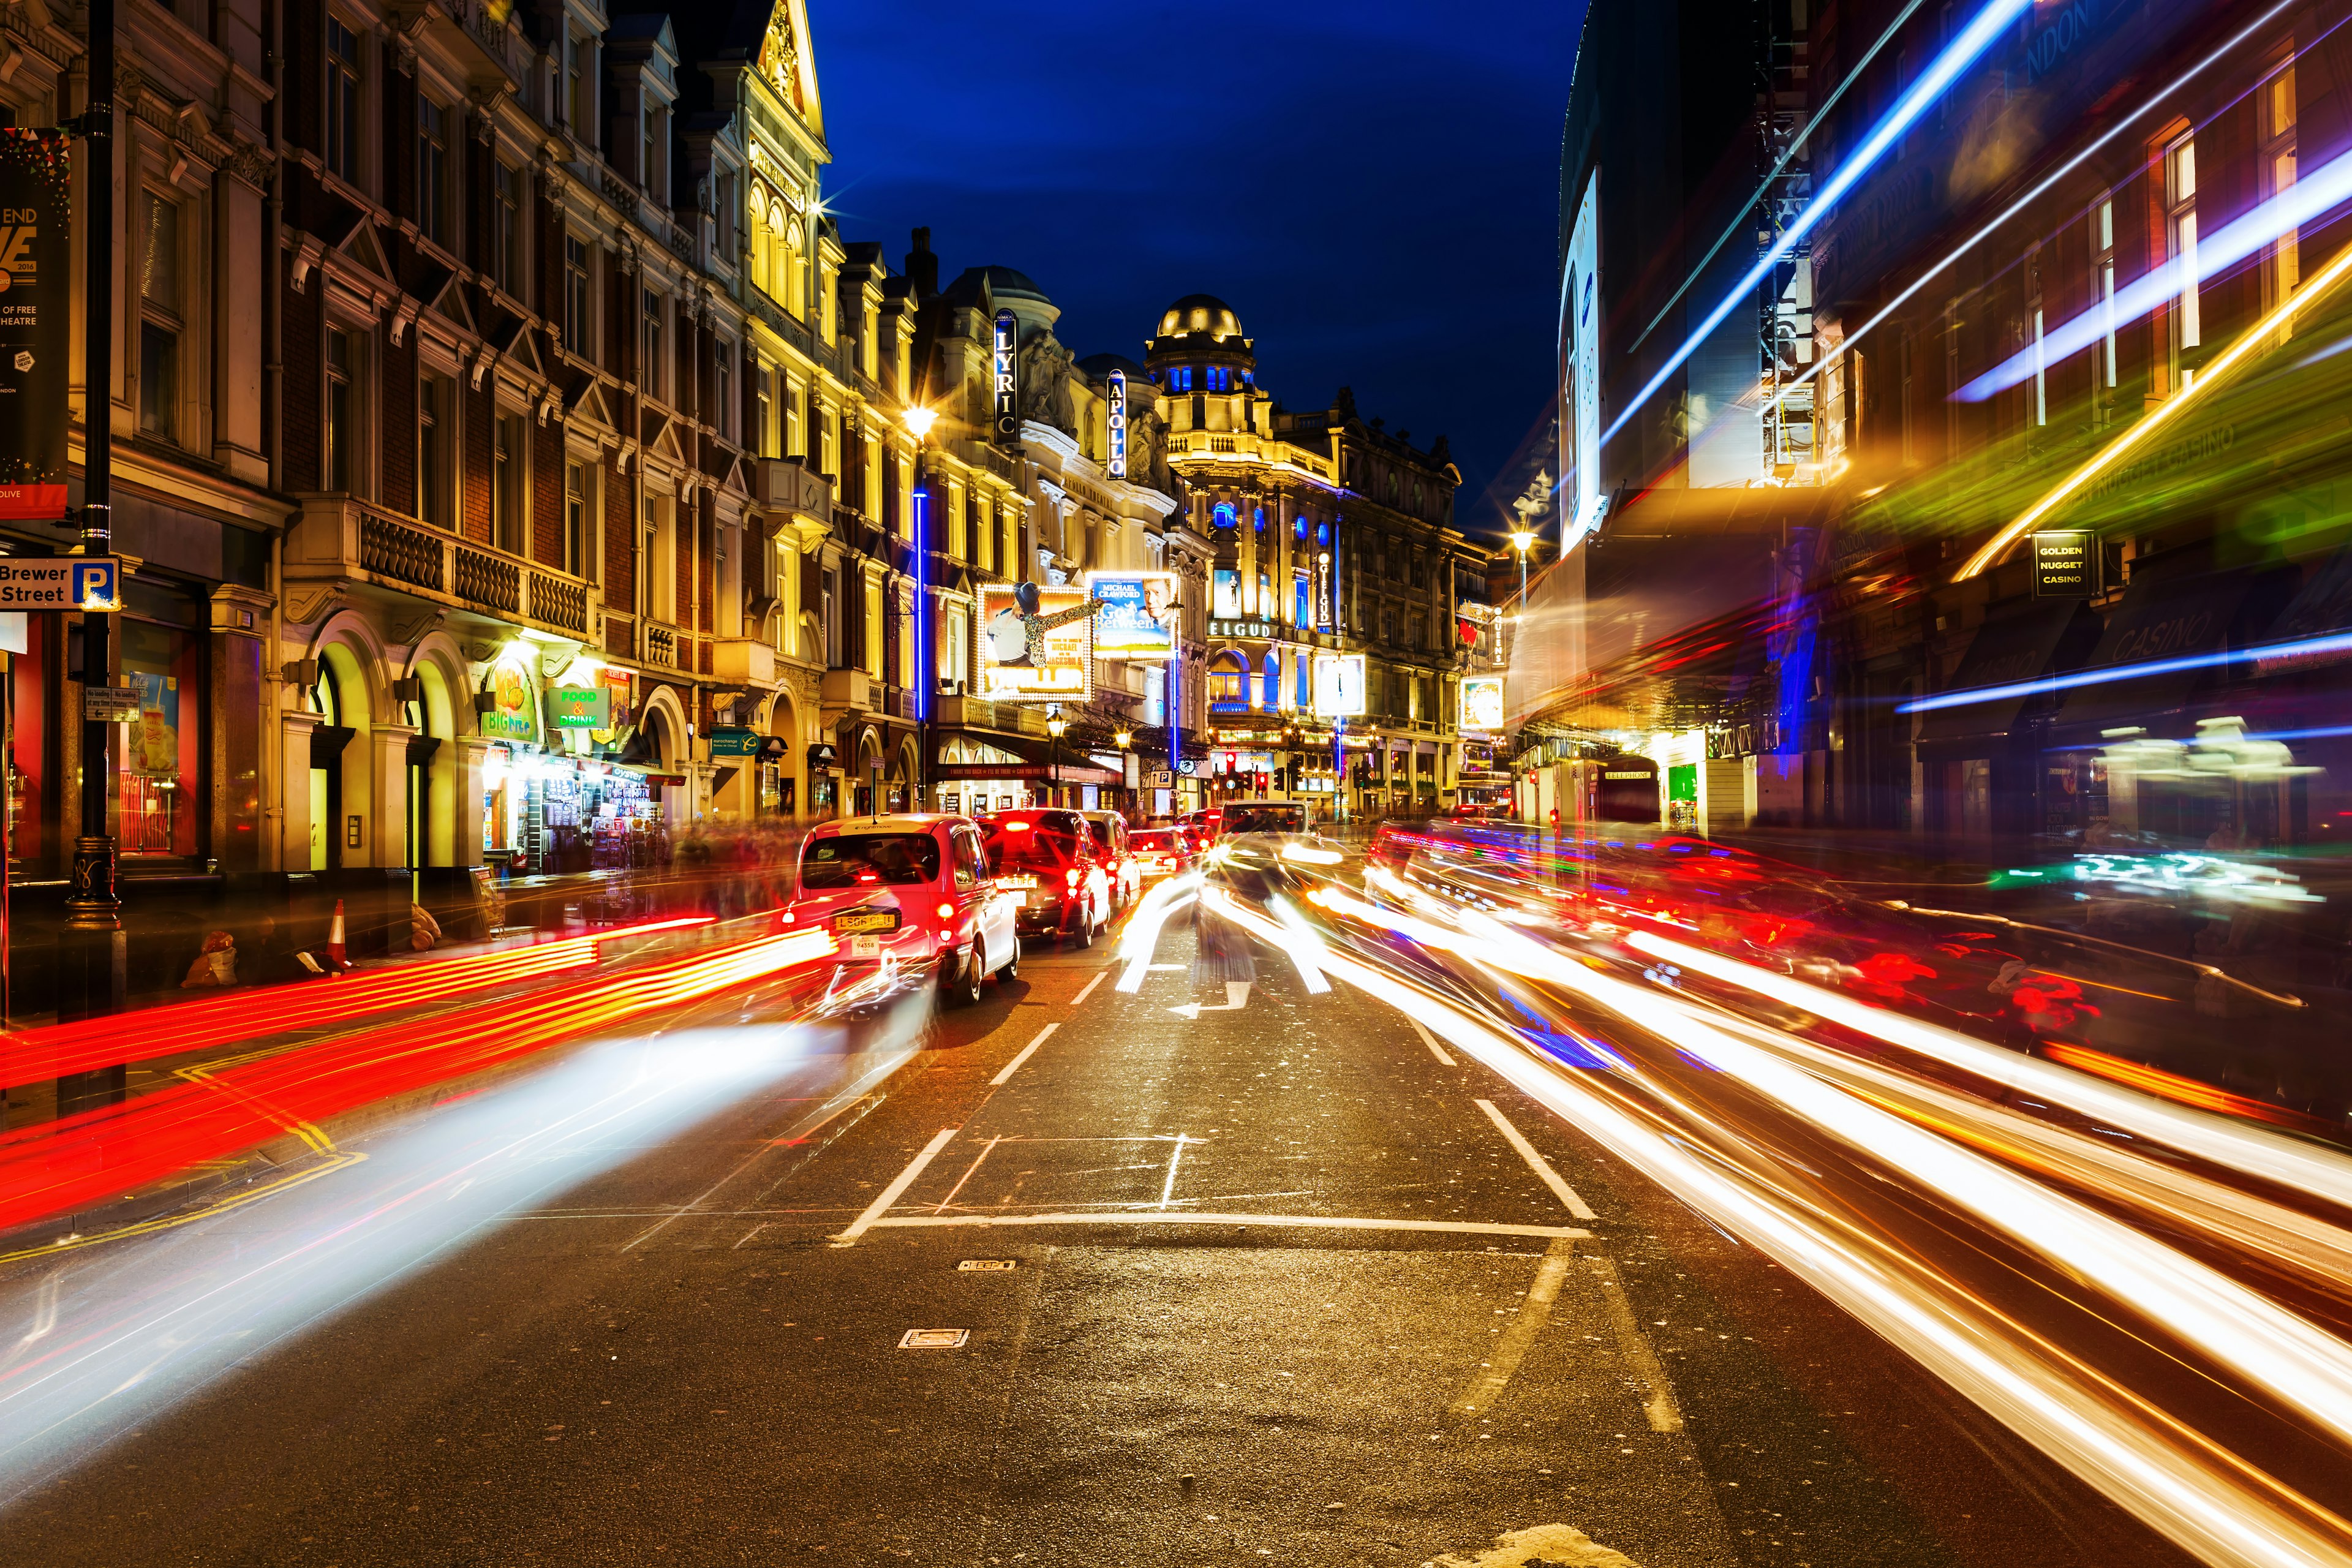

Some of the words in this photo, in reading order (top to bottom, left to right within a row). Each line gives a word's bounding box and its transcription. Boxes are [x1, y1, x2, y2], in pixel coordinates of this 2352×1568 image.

[3, 208, 37, 224] END
[997, 333, 1015, 434] LYRIC
[1109, 385, 1124, 474] APOLLO
[1065, 476, 1086, 496] APOLLO
[2040, 547, 2082, 556] GOLDEN
[0, 565, 67, 580] Brewer
[2040, 561, 2083, 570] NUGGET
[1, 587, 64, 601] Street
[1319, 564, 1329, 622] GIELGUD
[1094, 616, 1155, 630] Between
[1494, 616, 1503, 663] QUEENS
[2111, 611, 2212, 662] CASINO
[1052, 643, 1077, 652] MICHAEL
[1047, 657, 1076, 666] JACKSON
[1077, 657, 1082, 666] 5
[608, 669, 620, 679] TICKETS
[562, 692, 597, 702] FOOD
[573, 701, 584, 715] &
[559, 715, 597, 726] DRINK
[614, 768, 644, 781] oyster
[1161, 774, 1167, 782] P
[840, 917, 867, 927] LS06
